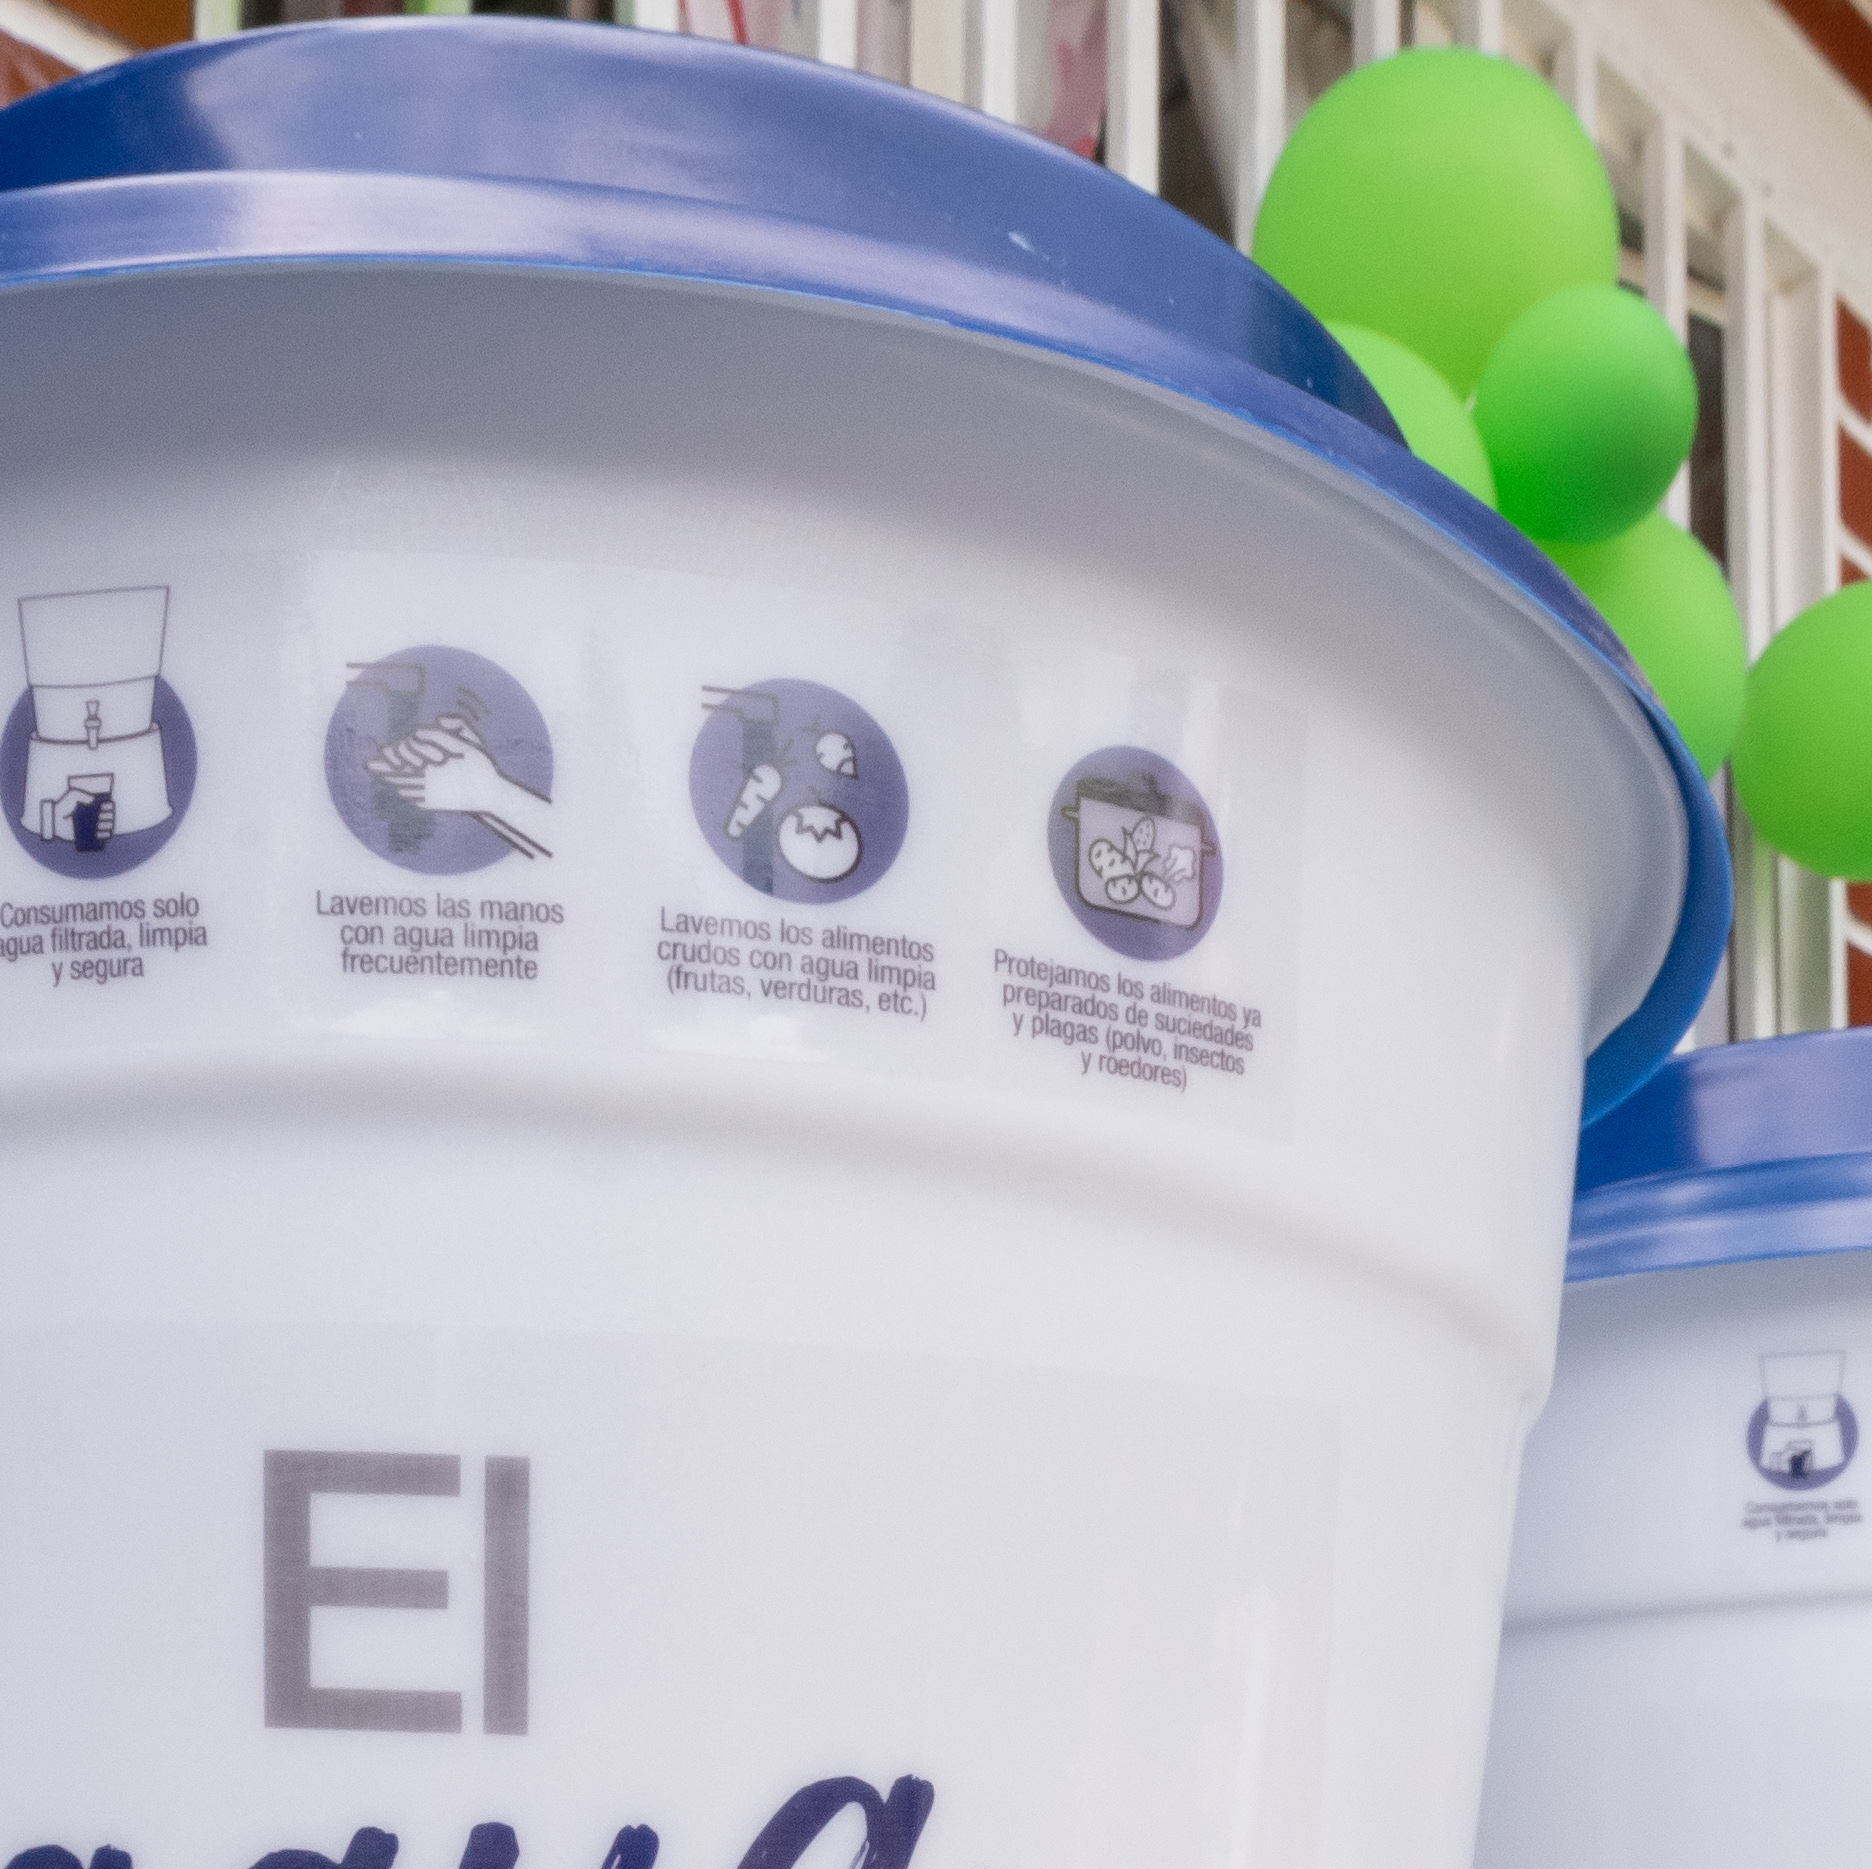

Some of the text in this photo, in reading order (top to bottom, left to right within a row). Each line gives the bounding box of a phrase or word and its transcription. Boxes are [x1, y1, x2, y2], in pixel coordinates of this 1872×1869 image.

[0, 893, 200, 927] Consumamos solo
[316, 890, 564, 924] Lavemos las manos
[50, 926, 132, 955] filtrada,
[139, 923, 207, 953] limpia
[340, 922, 538, 956] con agua limpia
[660, 907, 935, 961] Lavemos los alimentos
[51, 956, 145, 987] y segura
[341, 949, 538, 979] frecuentemente
[657, 937, 936, 992] crudos con agua limpia
[666, 965, 928, 1020] (frutas, verduras, etc.)
[993, 949, 1262, 1030] Protejamos los alimentos ya
[1002, 982, 1254, 1052] preparados de suciedades
[1012, 1012, 1245, 1076] y plagas (polvo, insectos
[1080, 1050, 1187, 1090] y roedores)
[263, 1450, 530, 1735] El
